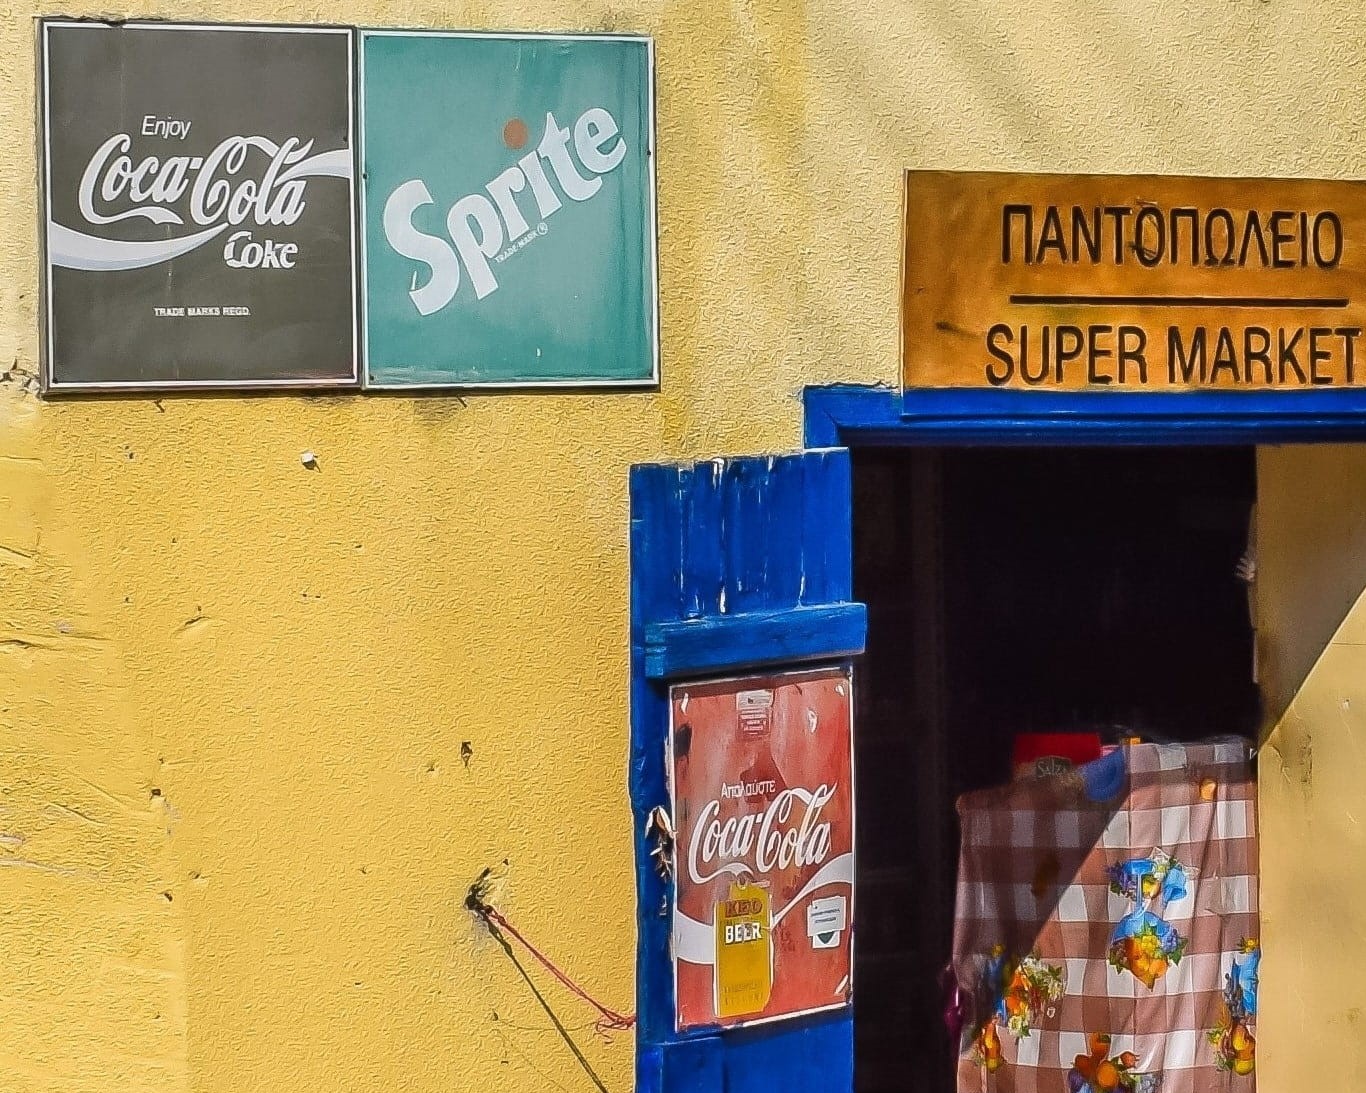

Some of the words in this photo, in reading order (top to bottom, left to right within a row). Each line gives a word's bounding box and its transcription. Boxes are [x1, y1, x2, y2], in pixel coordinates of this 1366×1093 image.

[141, 114, 192, 141] Enjoy
[78, 134, 316, 227] Coca-Cola
[382, 106, 627, 317] Sprite
[223, 230, 298, 269] Coke
[1001, 204, 1344, 269] ΠΑΝΤΟΠΩΛΕΙΟ
[153, 307, 185, 317] TRADE
[187, 307, 220, 316] MARKS
[985, 323, 1148, 387] SUPER
[1167, 324, 1363, 387] MARKET
[688, 781, 838, 884] Coca-Cola
[724, 922, 763, 945] BEER
